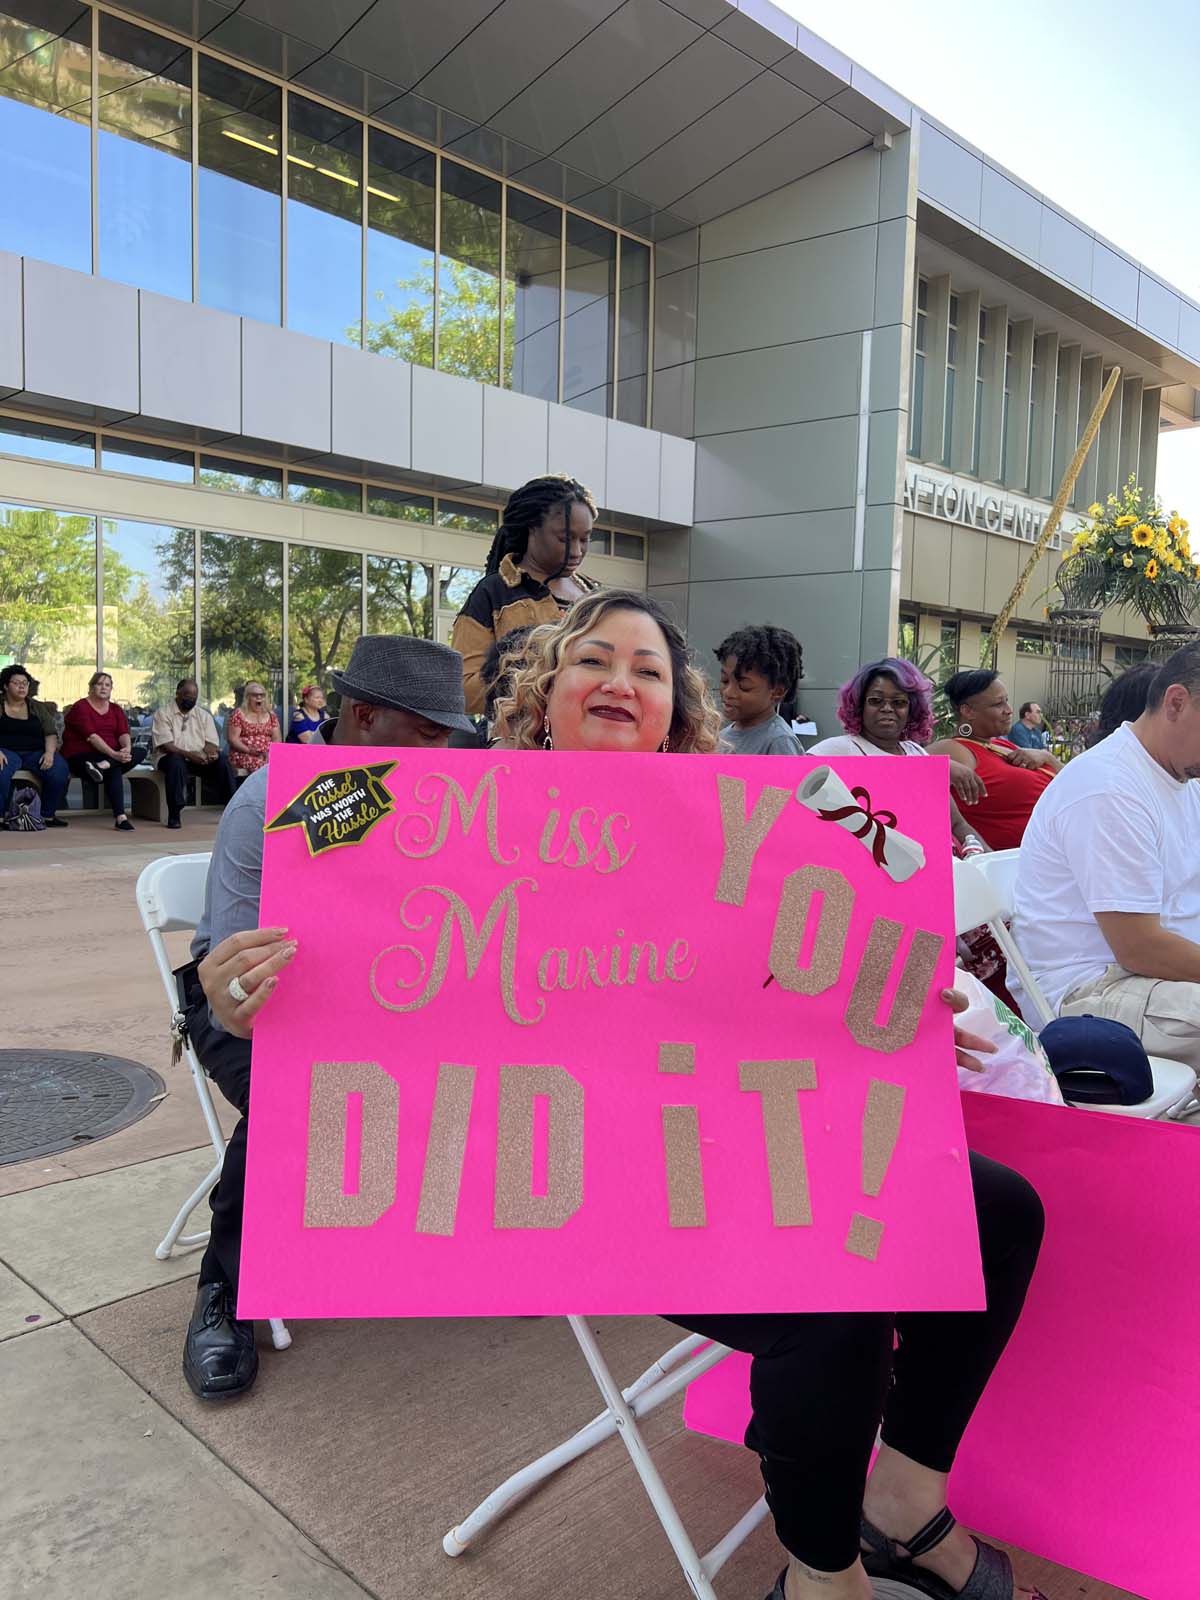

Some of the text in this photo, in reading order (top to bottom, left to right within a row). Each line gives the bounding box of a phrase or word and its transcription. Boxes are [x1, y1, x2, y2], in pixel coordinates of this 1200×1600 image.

[304, 772, 358, 811] Tassel
[310, 788, 367, 824] WAS WORTH
[317, 778, 336, 793] THE
[318, 802, 379, 843] Hassle
[334, 808, 354, 823] THE
[394, 764, 636, 873] Miss
[714, 773, 945, 1054] YOU
[369, 877, 699, 1026] Maxine
[303, 1061, 585, 1236] DID
